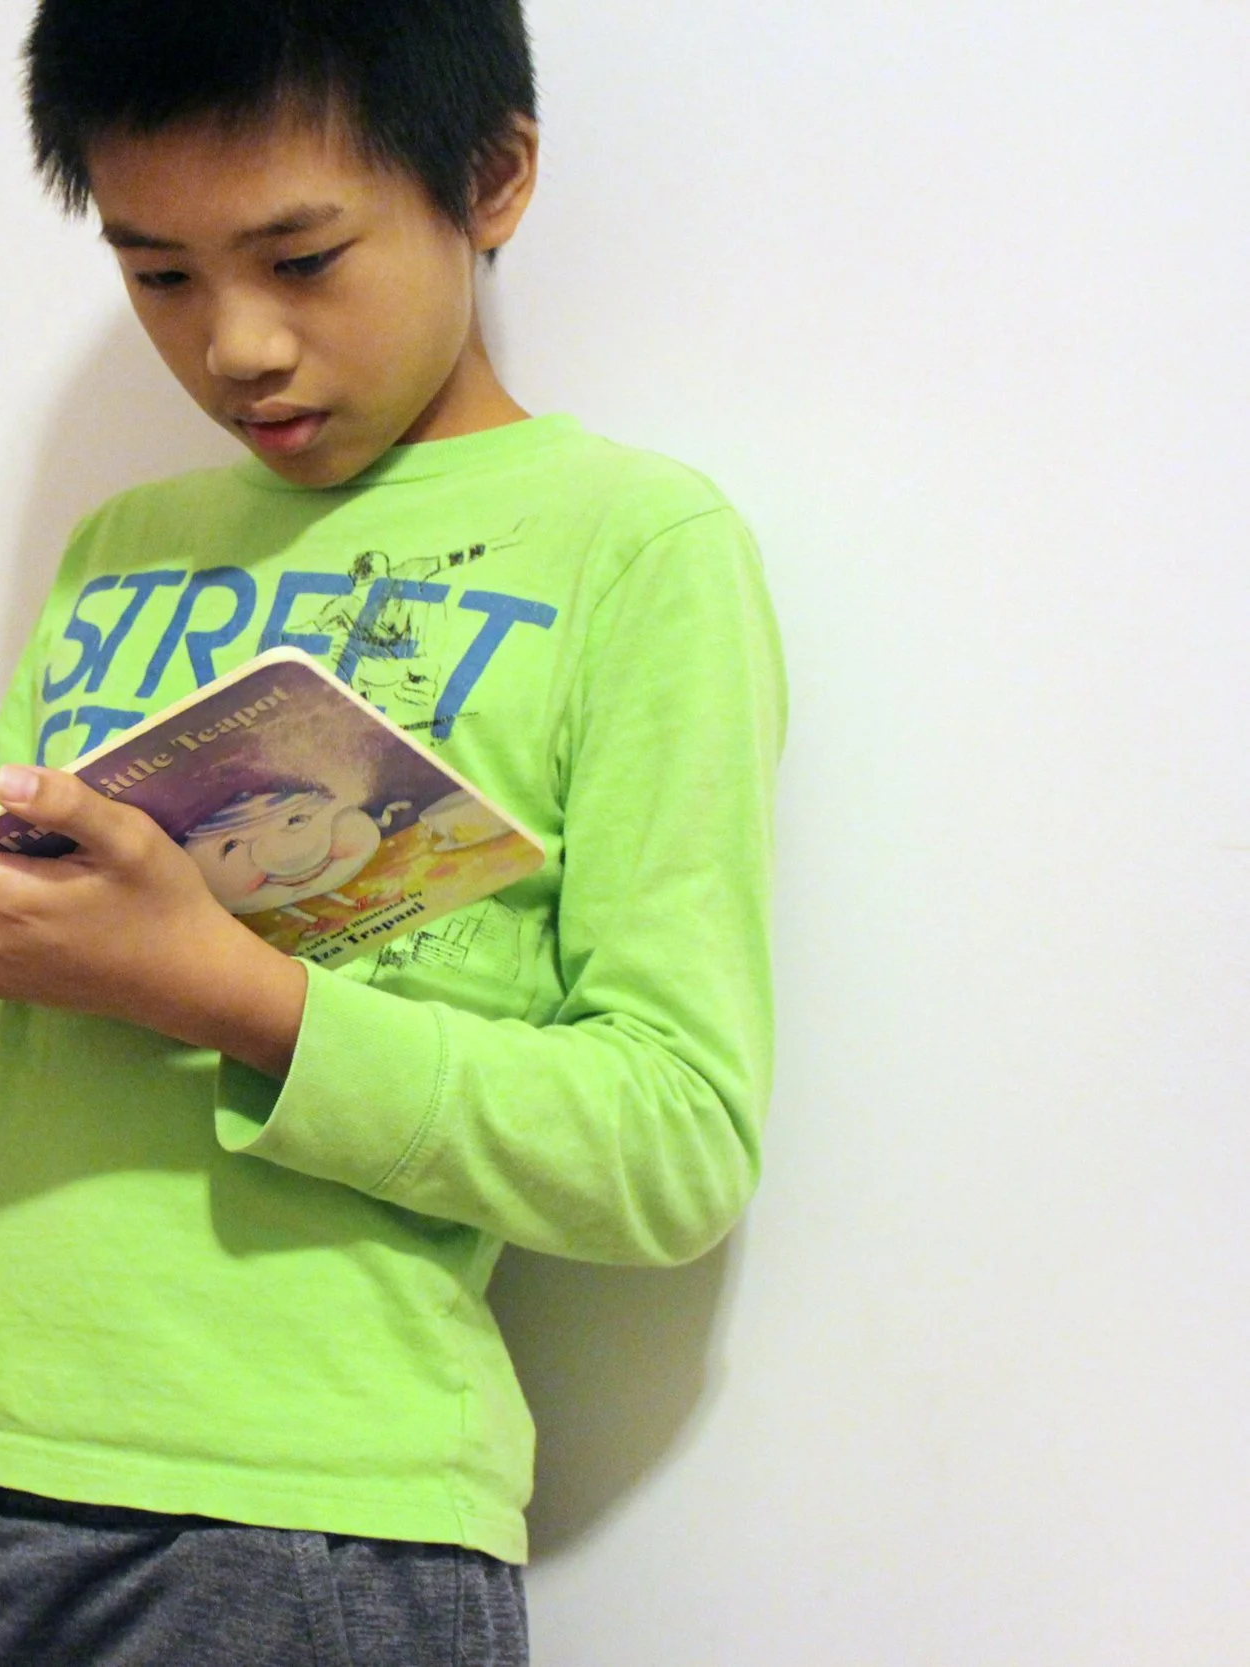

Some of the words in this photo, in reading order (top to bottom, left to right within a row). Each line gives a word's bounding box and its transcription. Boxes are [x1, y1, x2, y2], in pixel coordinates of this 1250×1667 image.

[41, 565, 559, 740] STREET
[100, 752, 174, 800] ittle
[169, 686, 291, 751] Teapot
[310, 946, 344, 964] Iza
[343, 902, 426, 944] Trapani
[351, 897, 406, 928] illustrated
